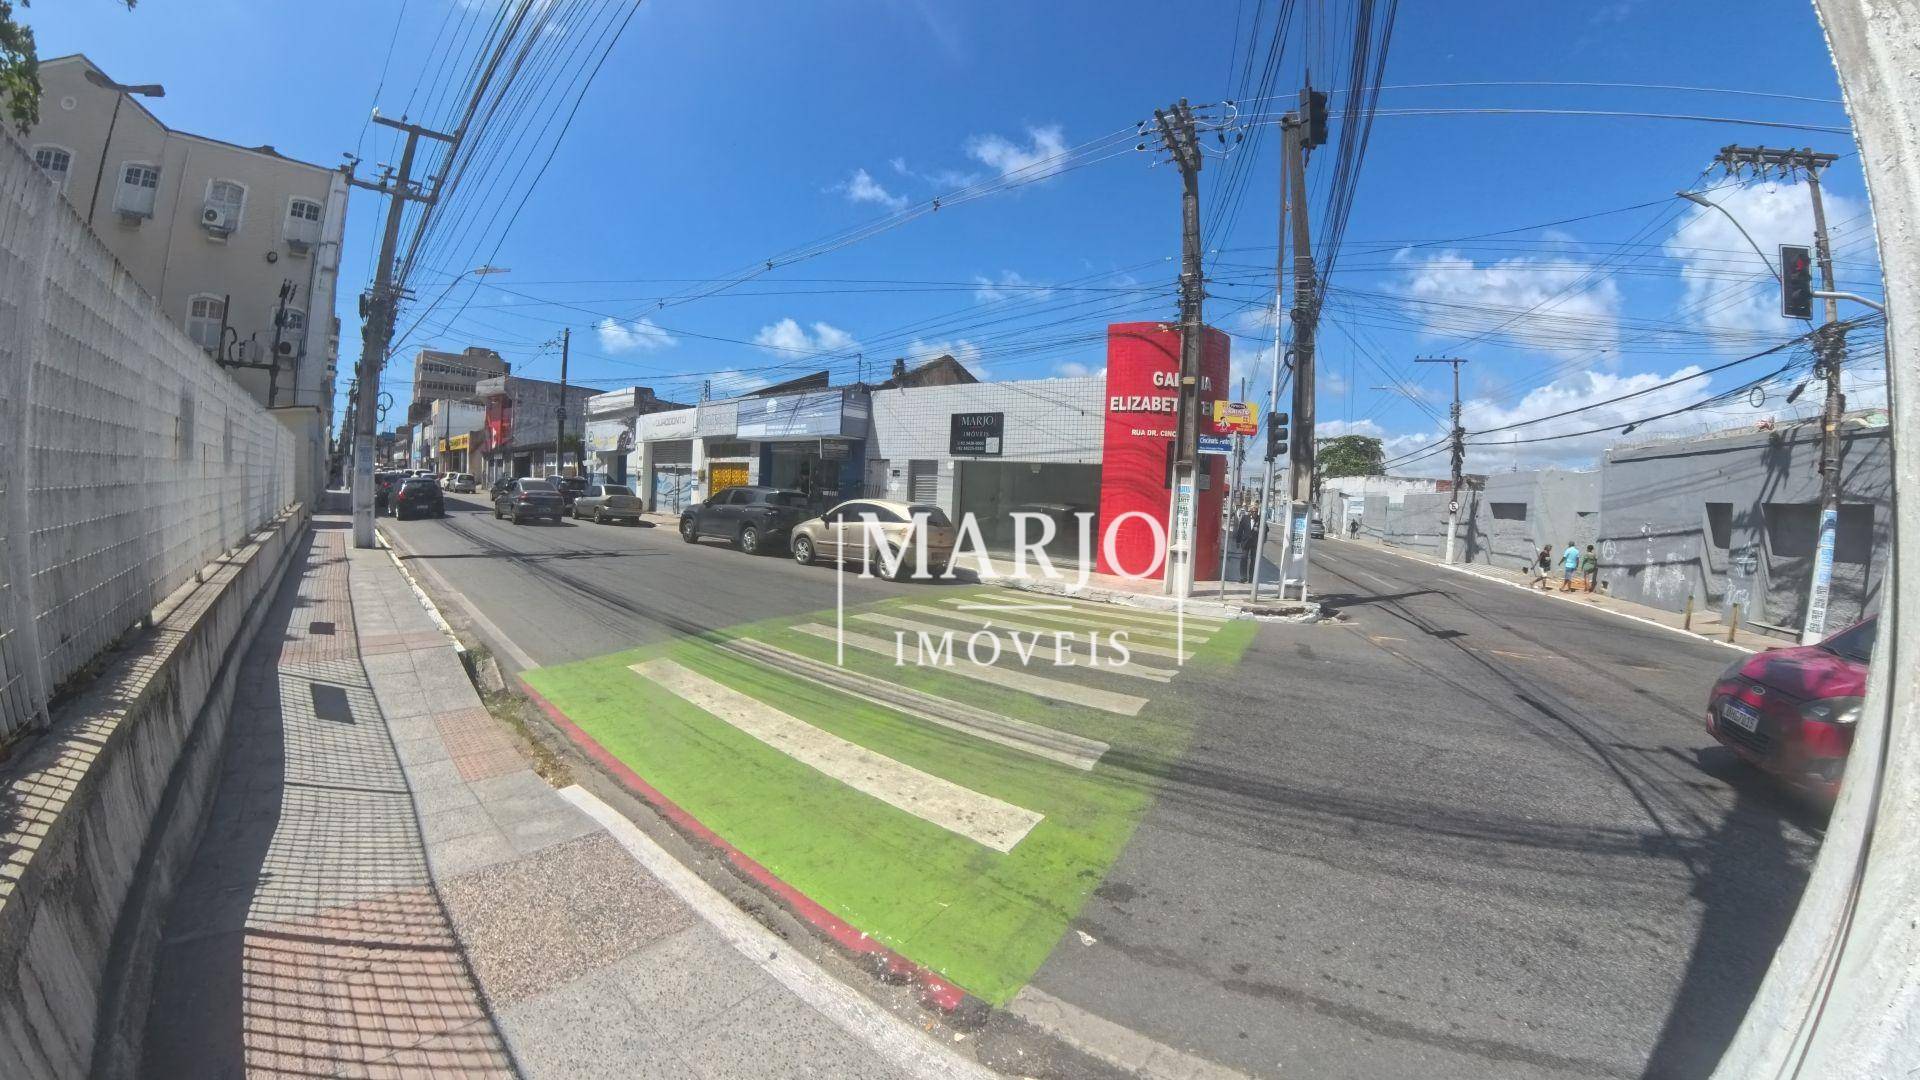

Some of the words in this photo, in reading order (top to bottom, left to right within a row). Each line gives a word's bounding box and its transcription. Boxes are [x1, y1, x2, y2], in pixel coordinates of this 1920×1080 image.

[961, 416, 994, 428] MARJO
[1131, 428, 1146, 436] RUA
[1147, 429, 1159, 437] DR.
